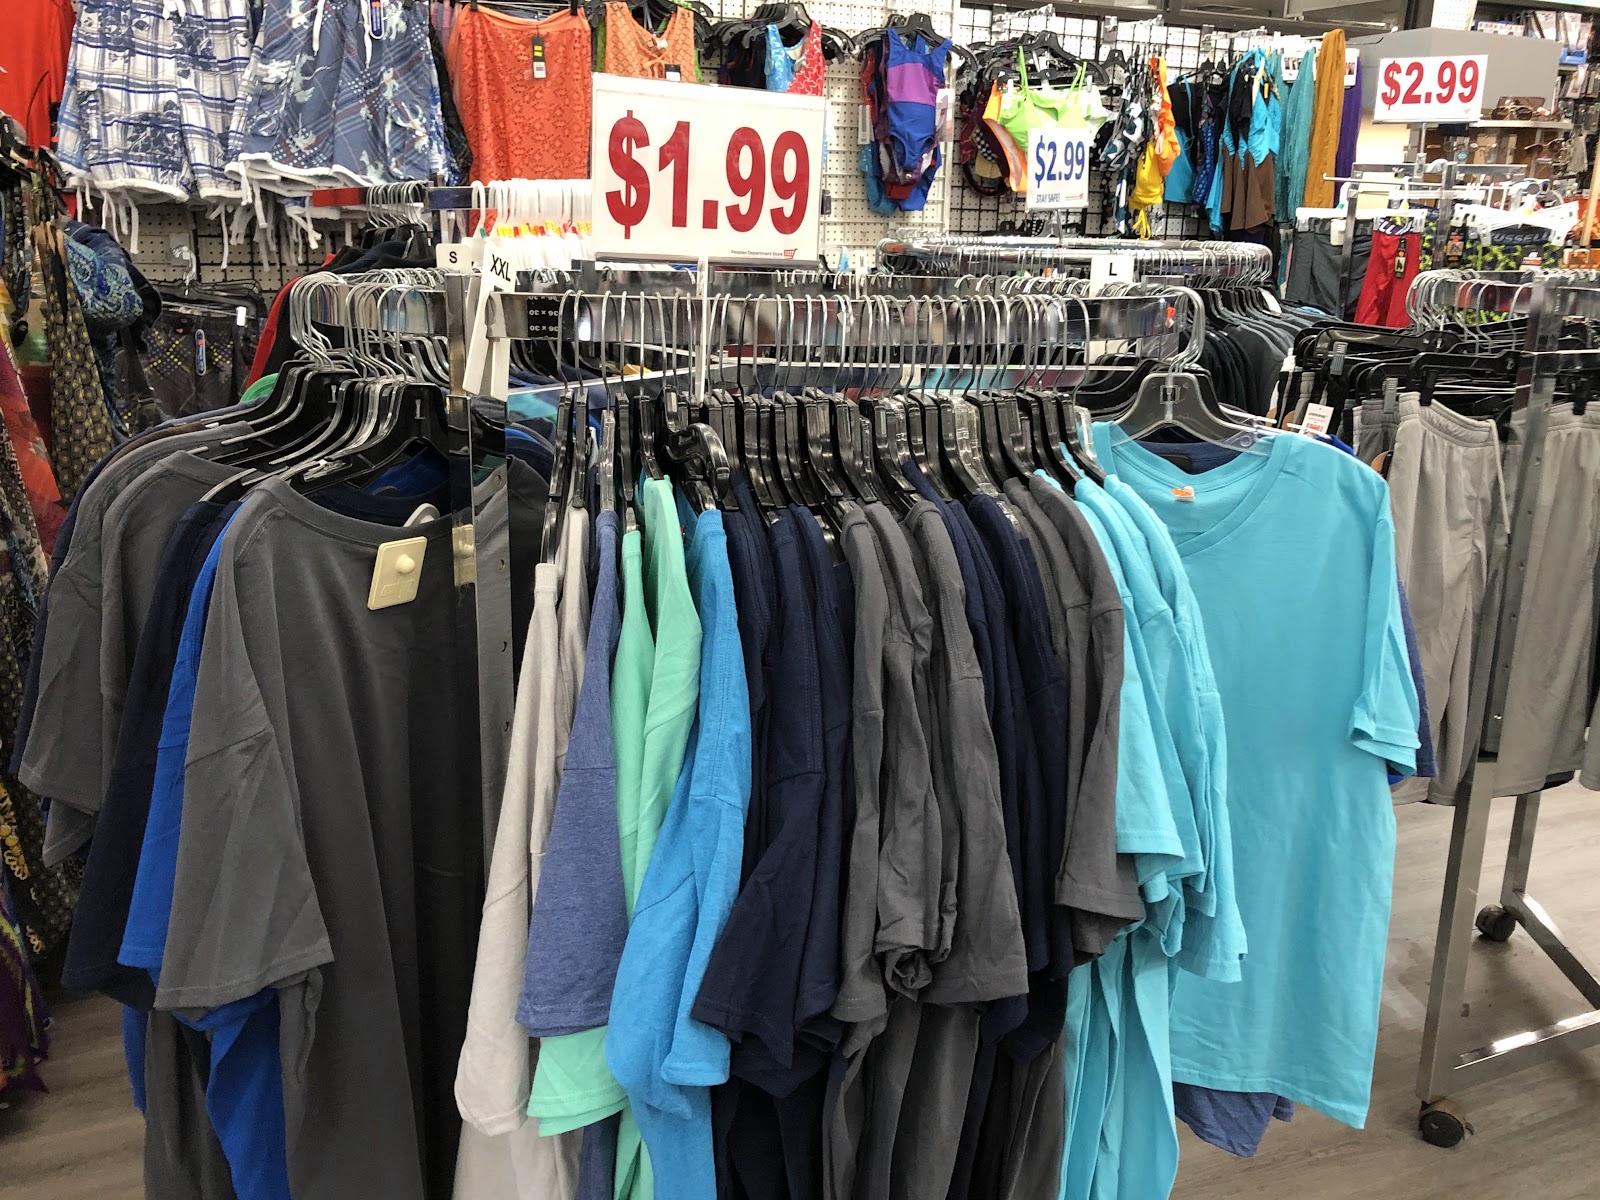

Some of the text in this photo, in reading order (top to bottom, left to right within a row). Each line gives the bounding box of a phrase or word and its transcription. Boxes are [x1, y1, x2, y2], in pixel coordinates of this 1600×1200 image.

[1381, 60, 1479, 110] $2.99
[606, 110, 810, 239] $1.99
[1035, 135, 1085, 188] $2.99
[449, 251, 458, 264] S
[490, 253, 511, 282] XXL
[1109, 262, 1118, 276] L
